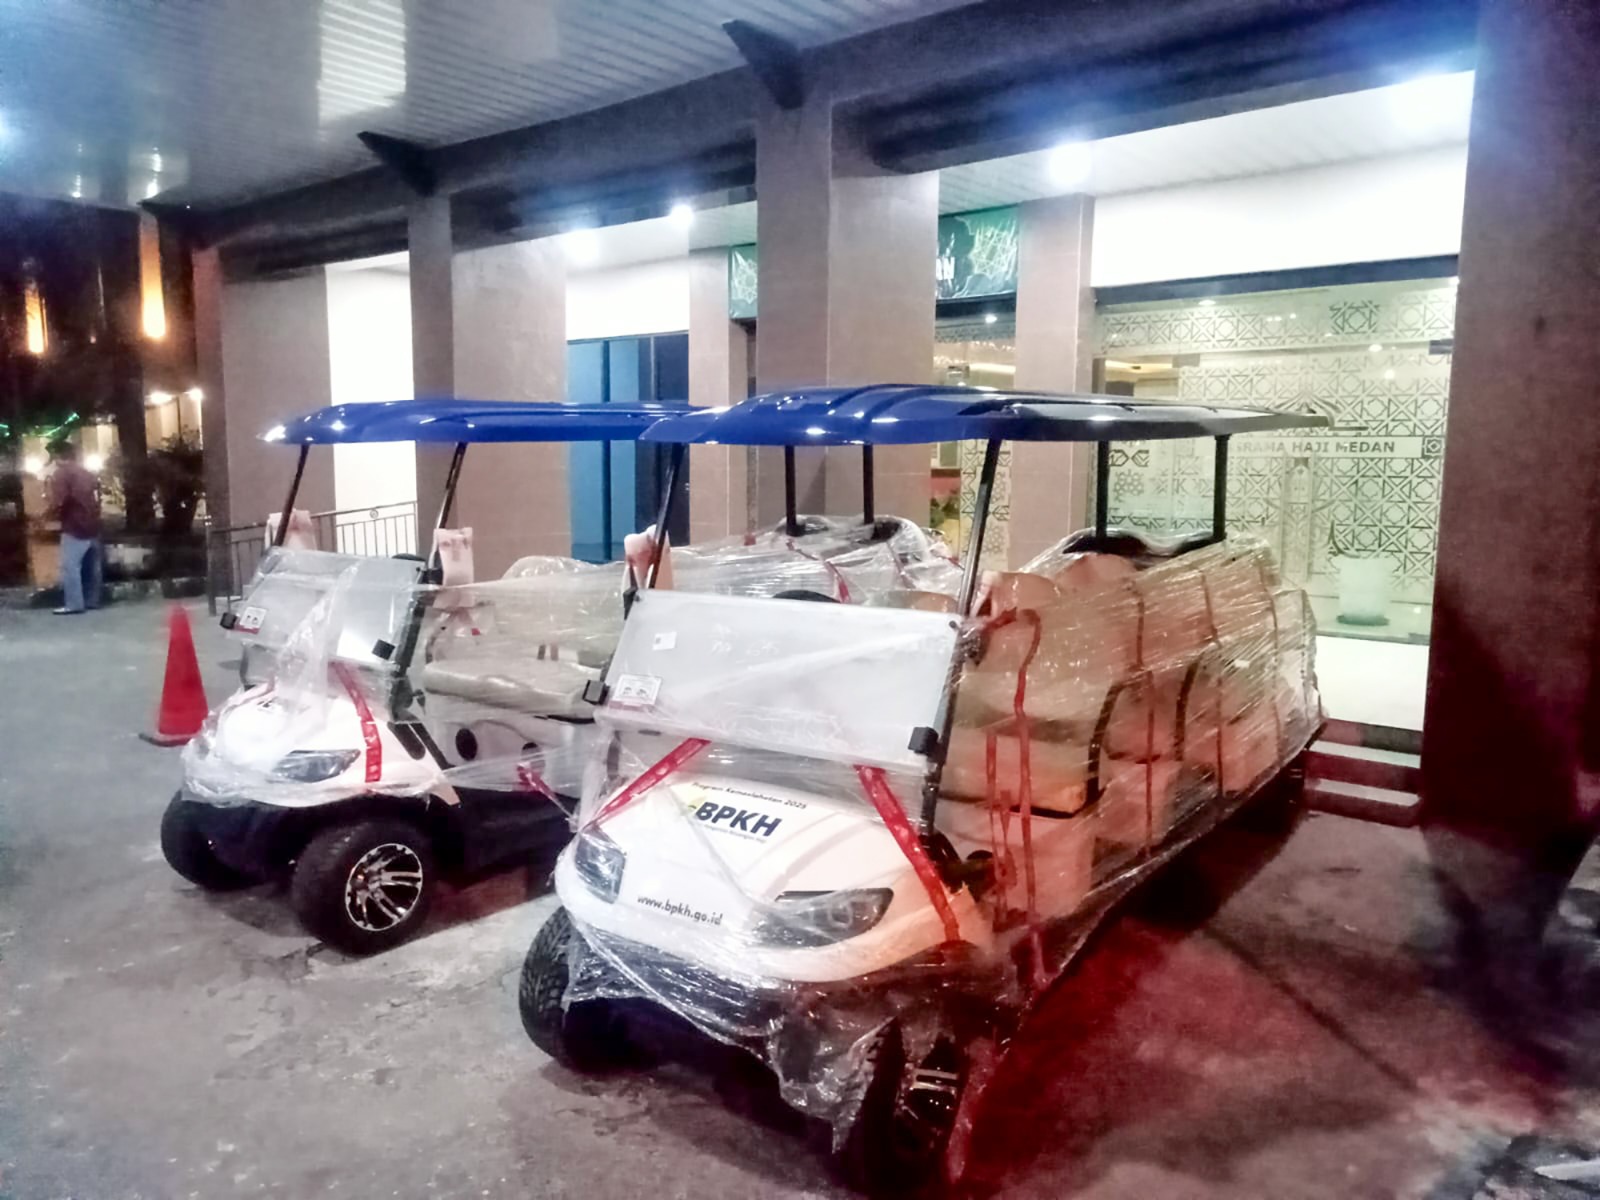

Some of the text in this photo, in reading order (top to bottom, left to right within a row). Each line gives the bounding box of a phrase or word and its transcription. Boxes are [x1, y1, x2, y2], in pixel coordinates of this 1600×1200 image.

[1292, 441, 1329, 453] HAJI
[1335, 441, 1395, 453] MEDAN
[695, 801, 783, 837] BPKH
[637, 897, 723, 926] www.bpkh.go.id
